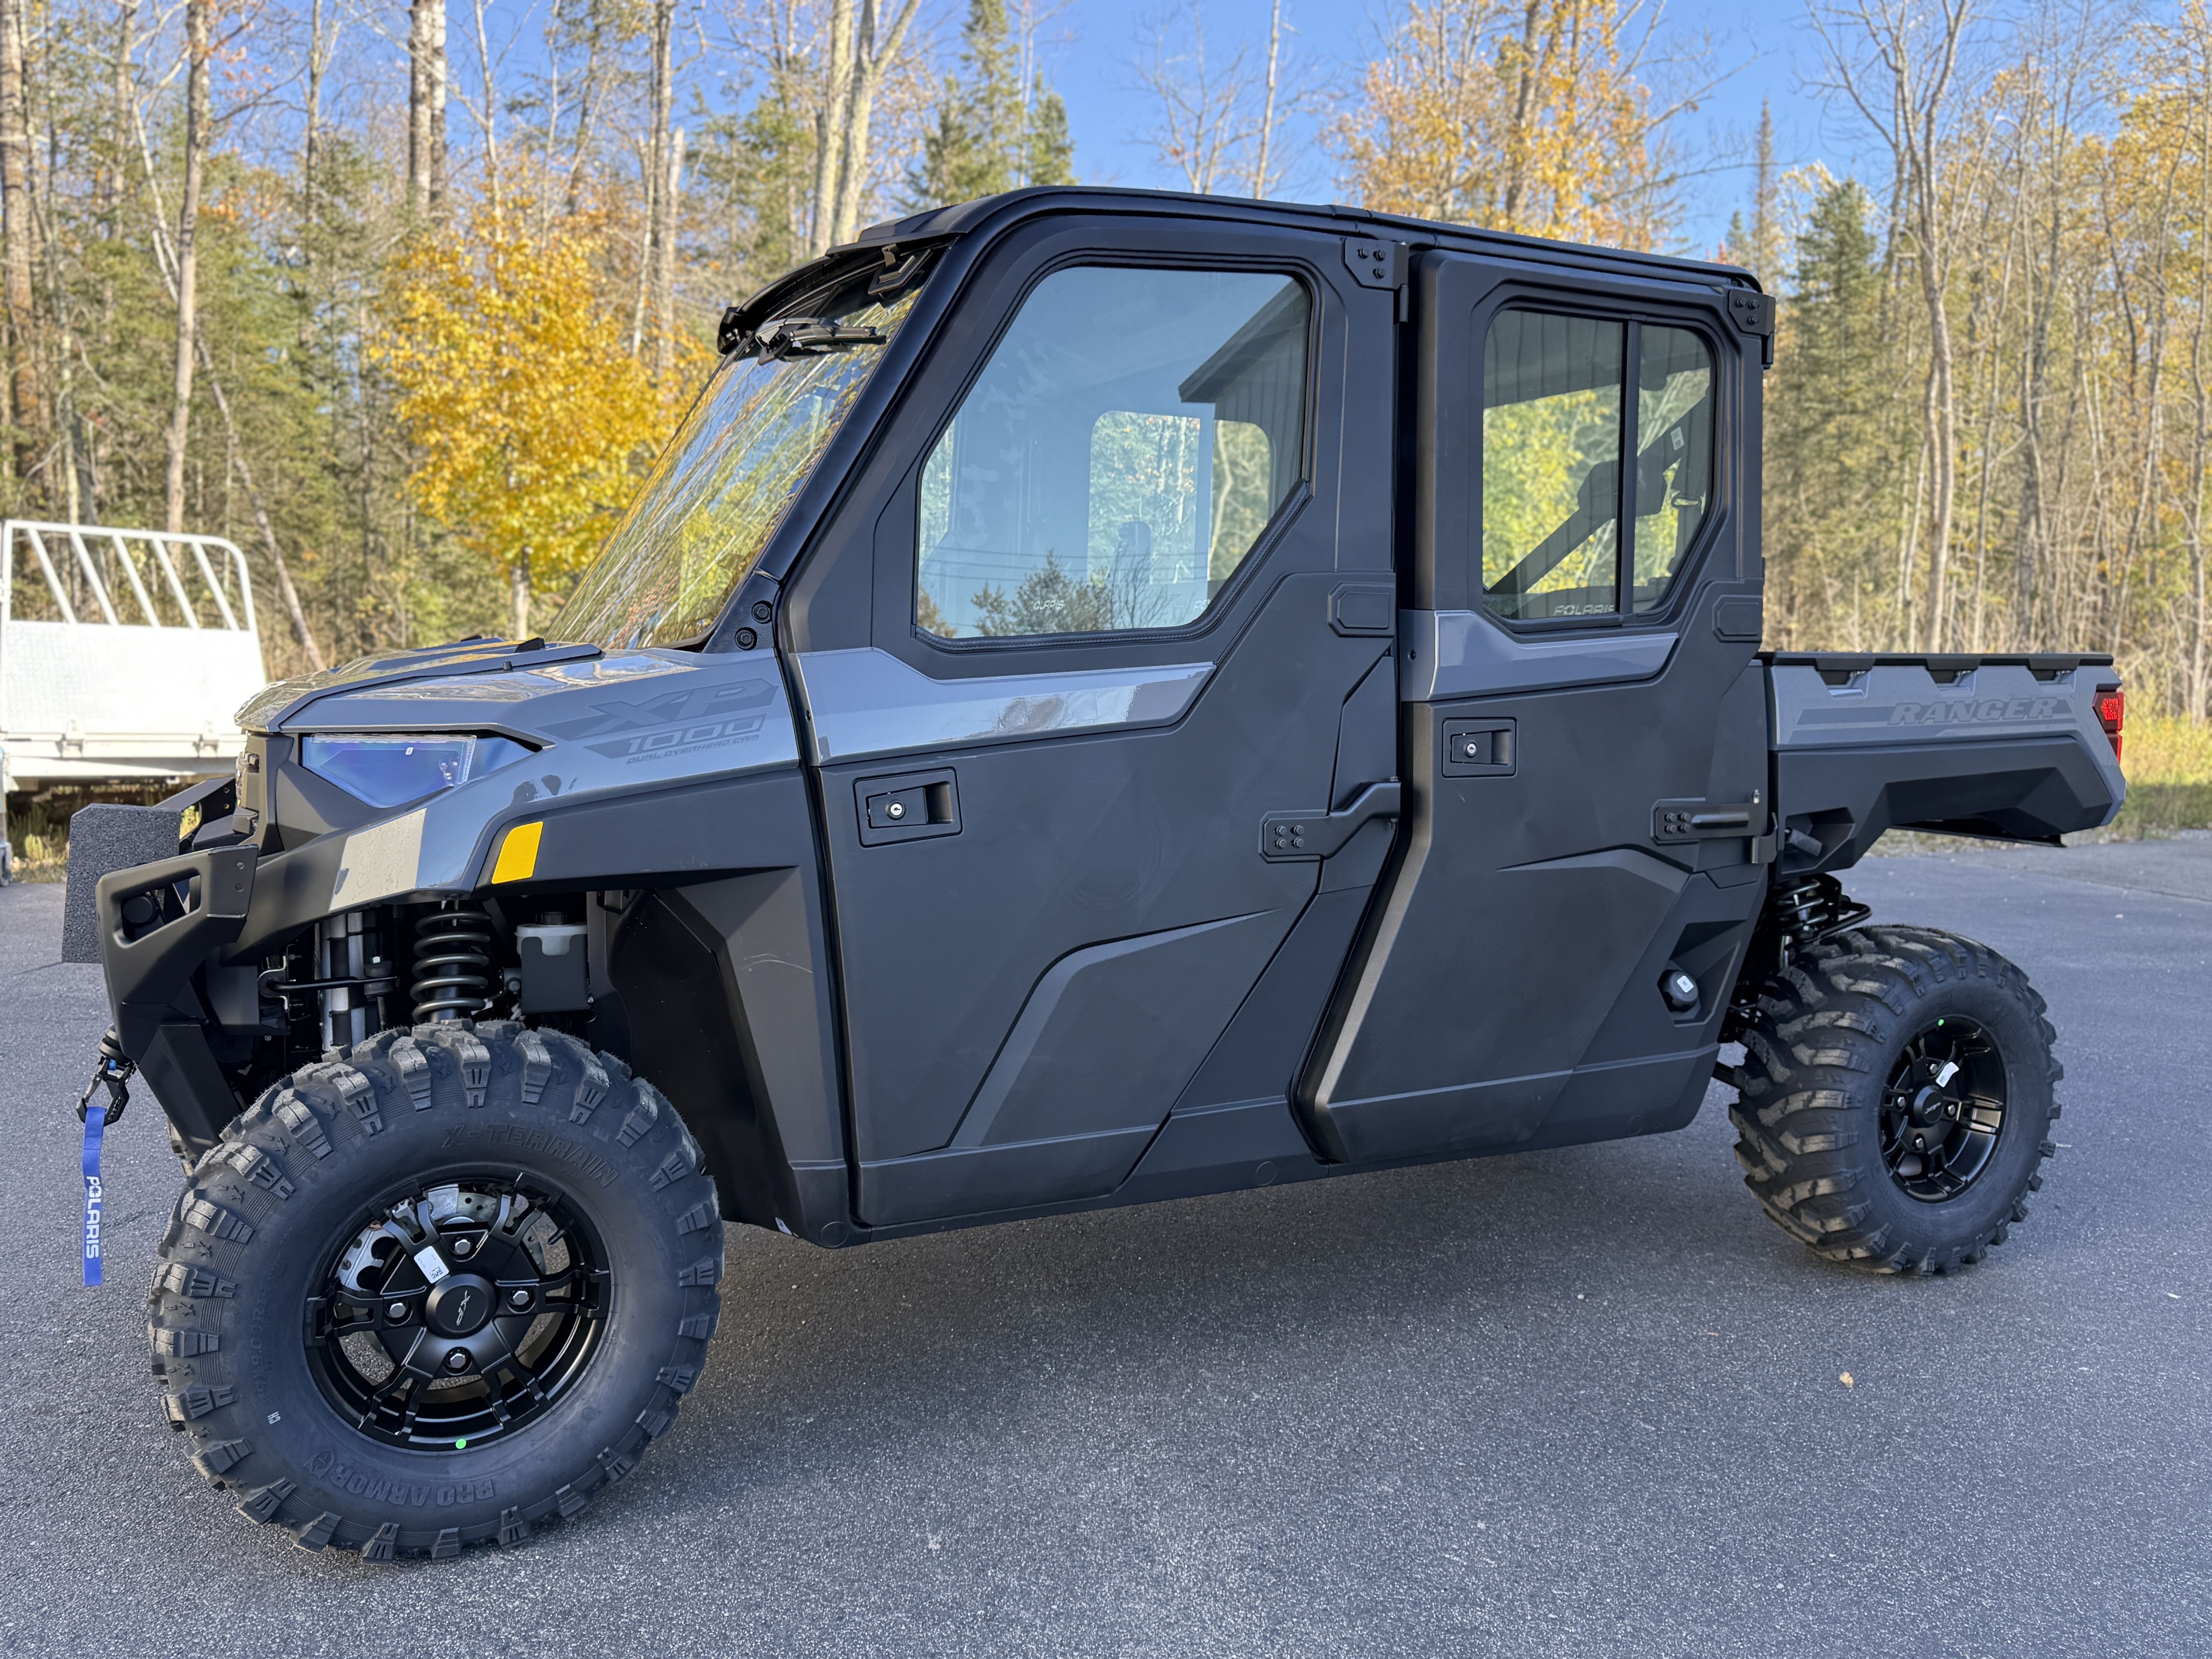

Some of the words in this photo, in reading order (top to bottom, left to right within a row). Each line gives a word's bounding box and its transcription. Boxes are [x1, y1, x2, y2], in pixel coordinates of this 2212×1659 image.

[1553, 605, 1614, 616] POLARIS
[577, 678, 774, 738] XP
[1886, 697, 2059, 725] RANGER
[626, 753, 660, 765] DUAL
[664, 740, 730, 756] OVERHEAD
[732, 734, 759, 744] CAM
[628, 719, 761, 754] 1000
[441, 1123, 620, 1188] X-TERRAIN
[86, 1176, 102, 1259] POLARIS
[329, 1464, 431, 1507] ARMOR
[436, 1479, 495, 1506] PRO
